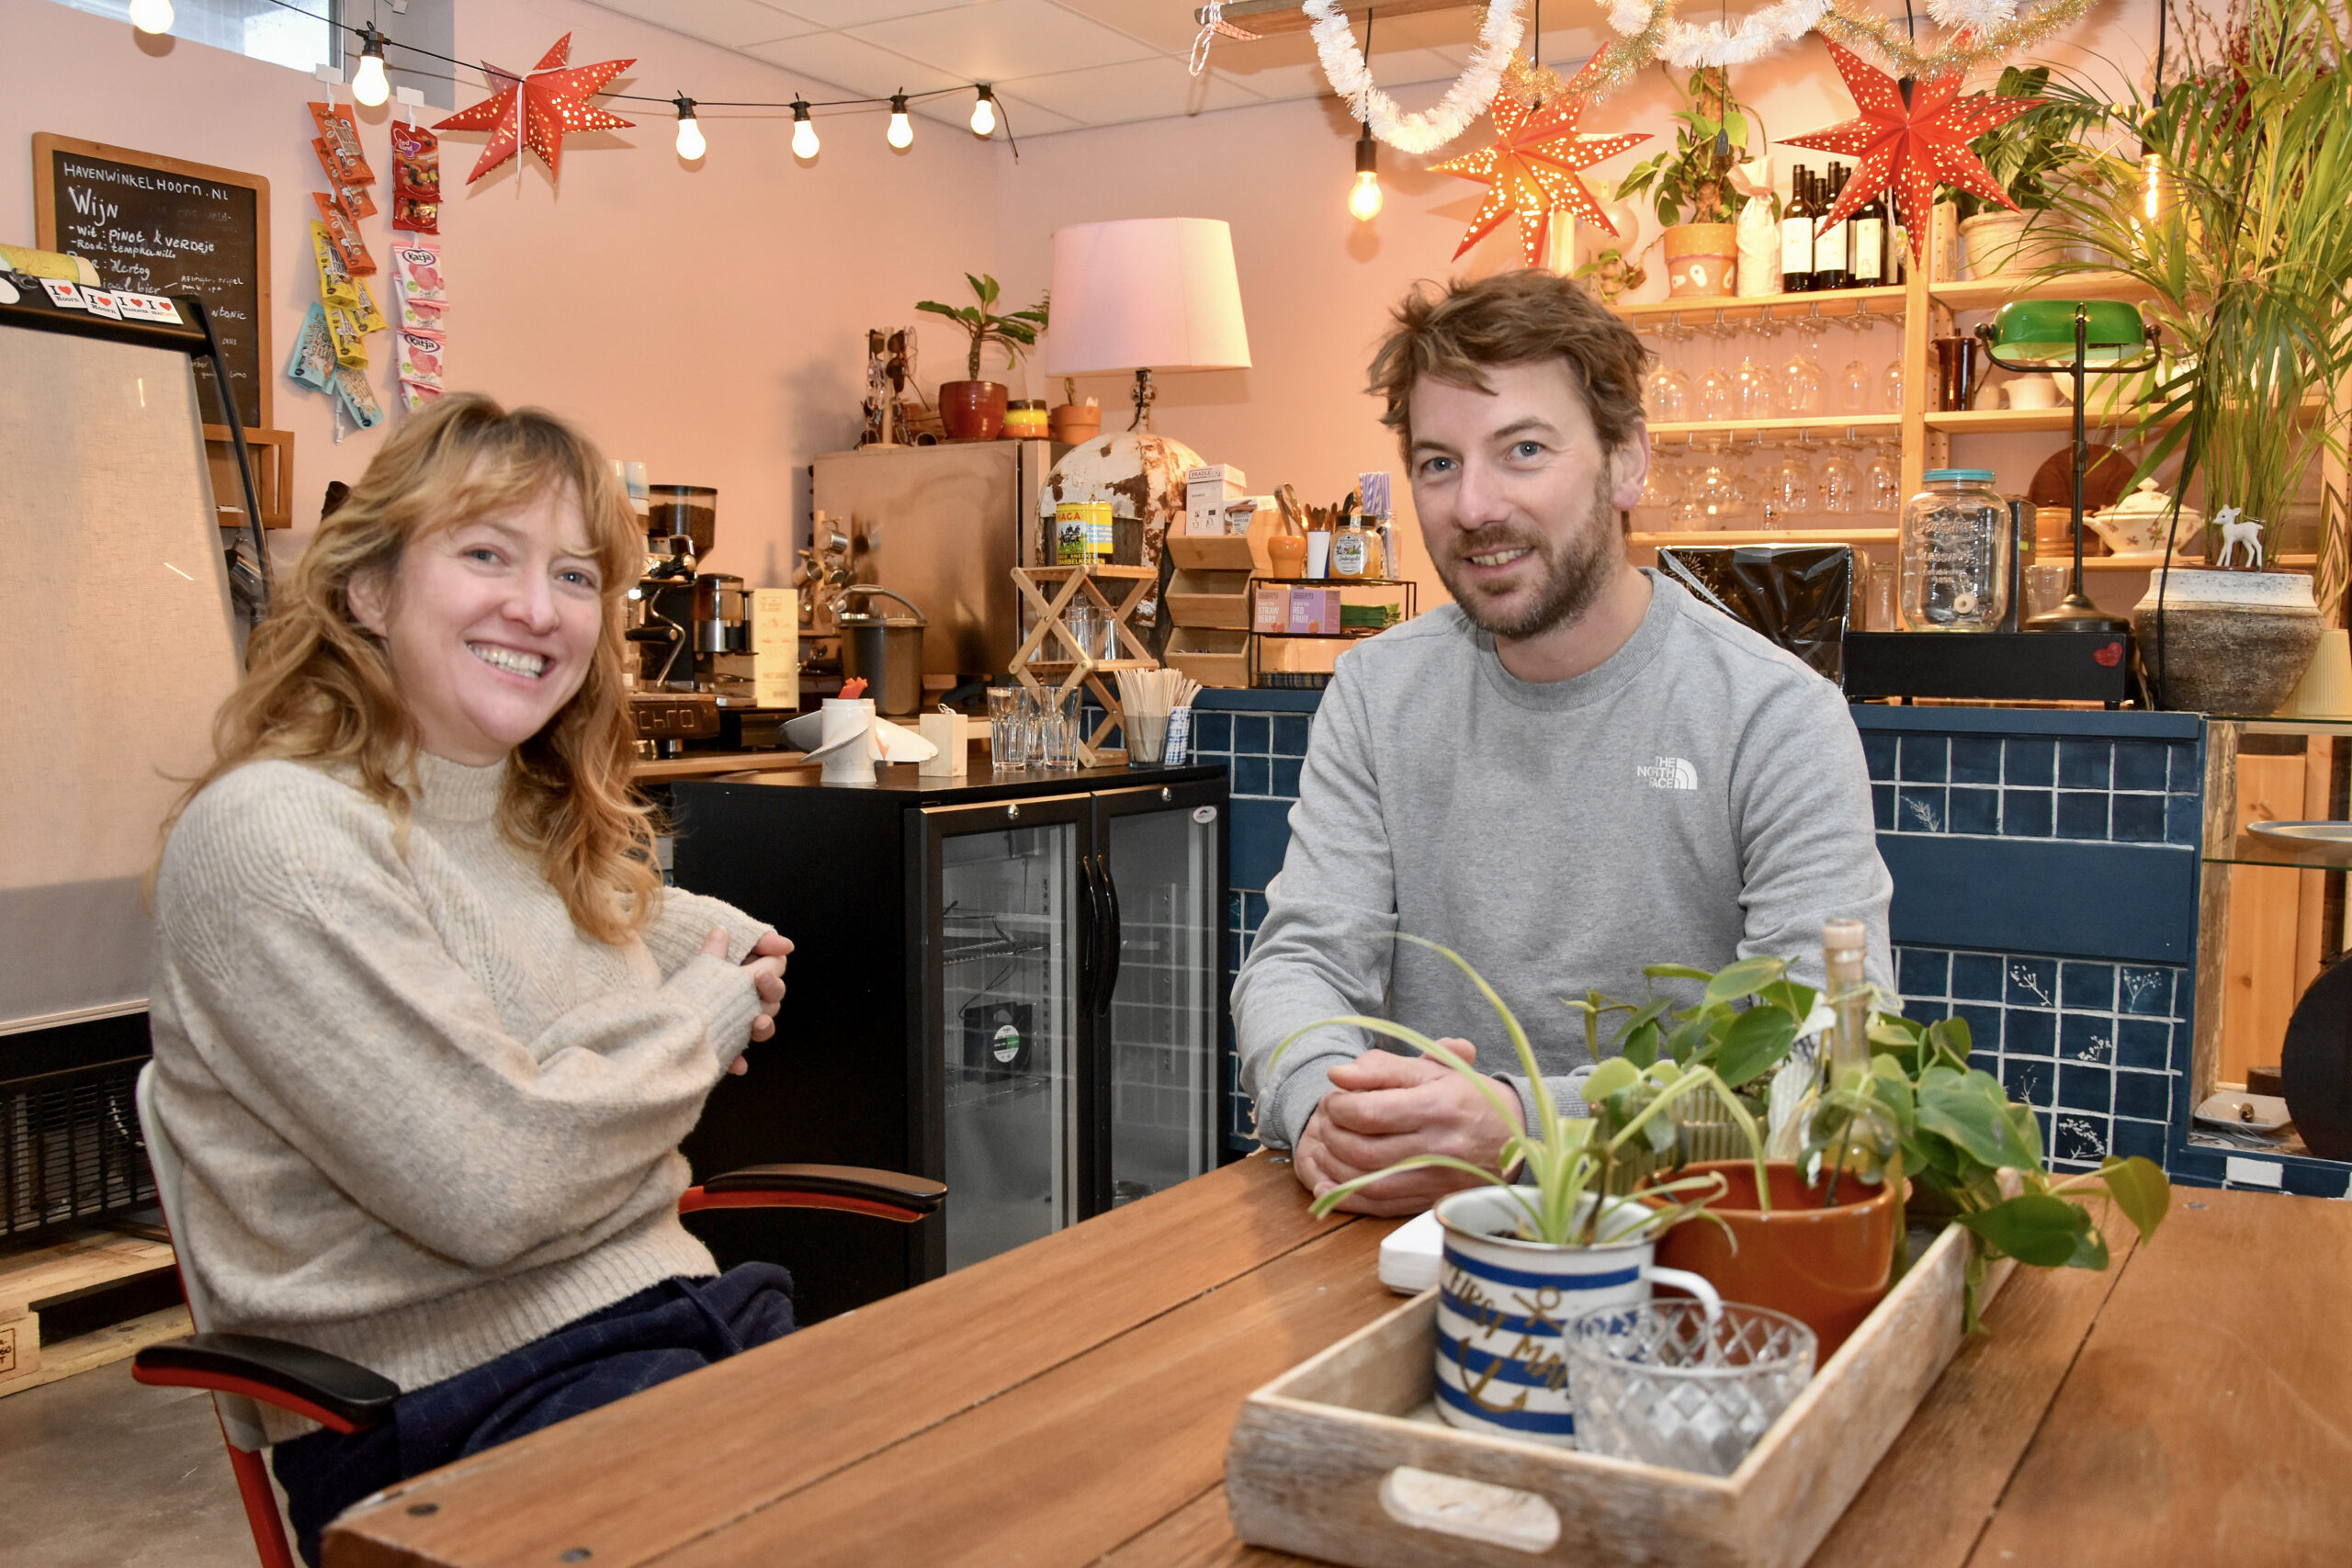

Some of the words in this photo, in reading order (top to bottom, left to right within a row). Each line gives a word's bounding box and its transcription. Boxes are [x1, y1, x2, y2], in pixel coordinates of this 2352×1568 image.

[408, 252, 432, 263] Katja
[109, 258, 151, 281] Hertog
[48, 285, 61, 296] I
[137, 281, 162, 295] bier
[87, 294, 98, 305] I
[409, 336, 435, 350] Katja
[1258, 606, 1279, 615] STRAW
[1293, 606, 1305, 615] RED
[1258, 615, 1276, 624] BERRY
[1292, 615, 1308, 624] FRUIT
[1655, 756, 1676, 768] THE
[1637, 765, 1675, 778] NORTH
[1648, 777, 1674, 789] FACE
